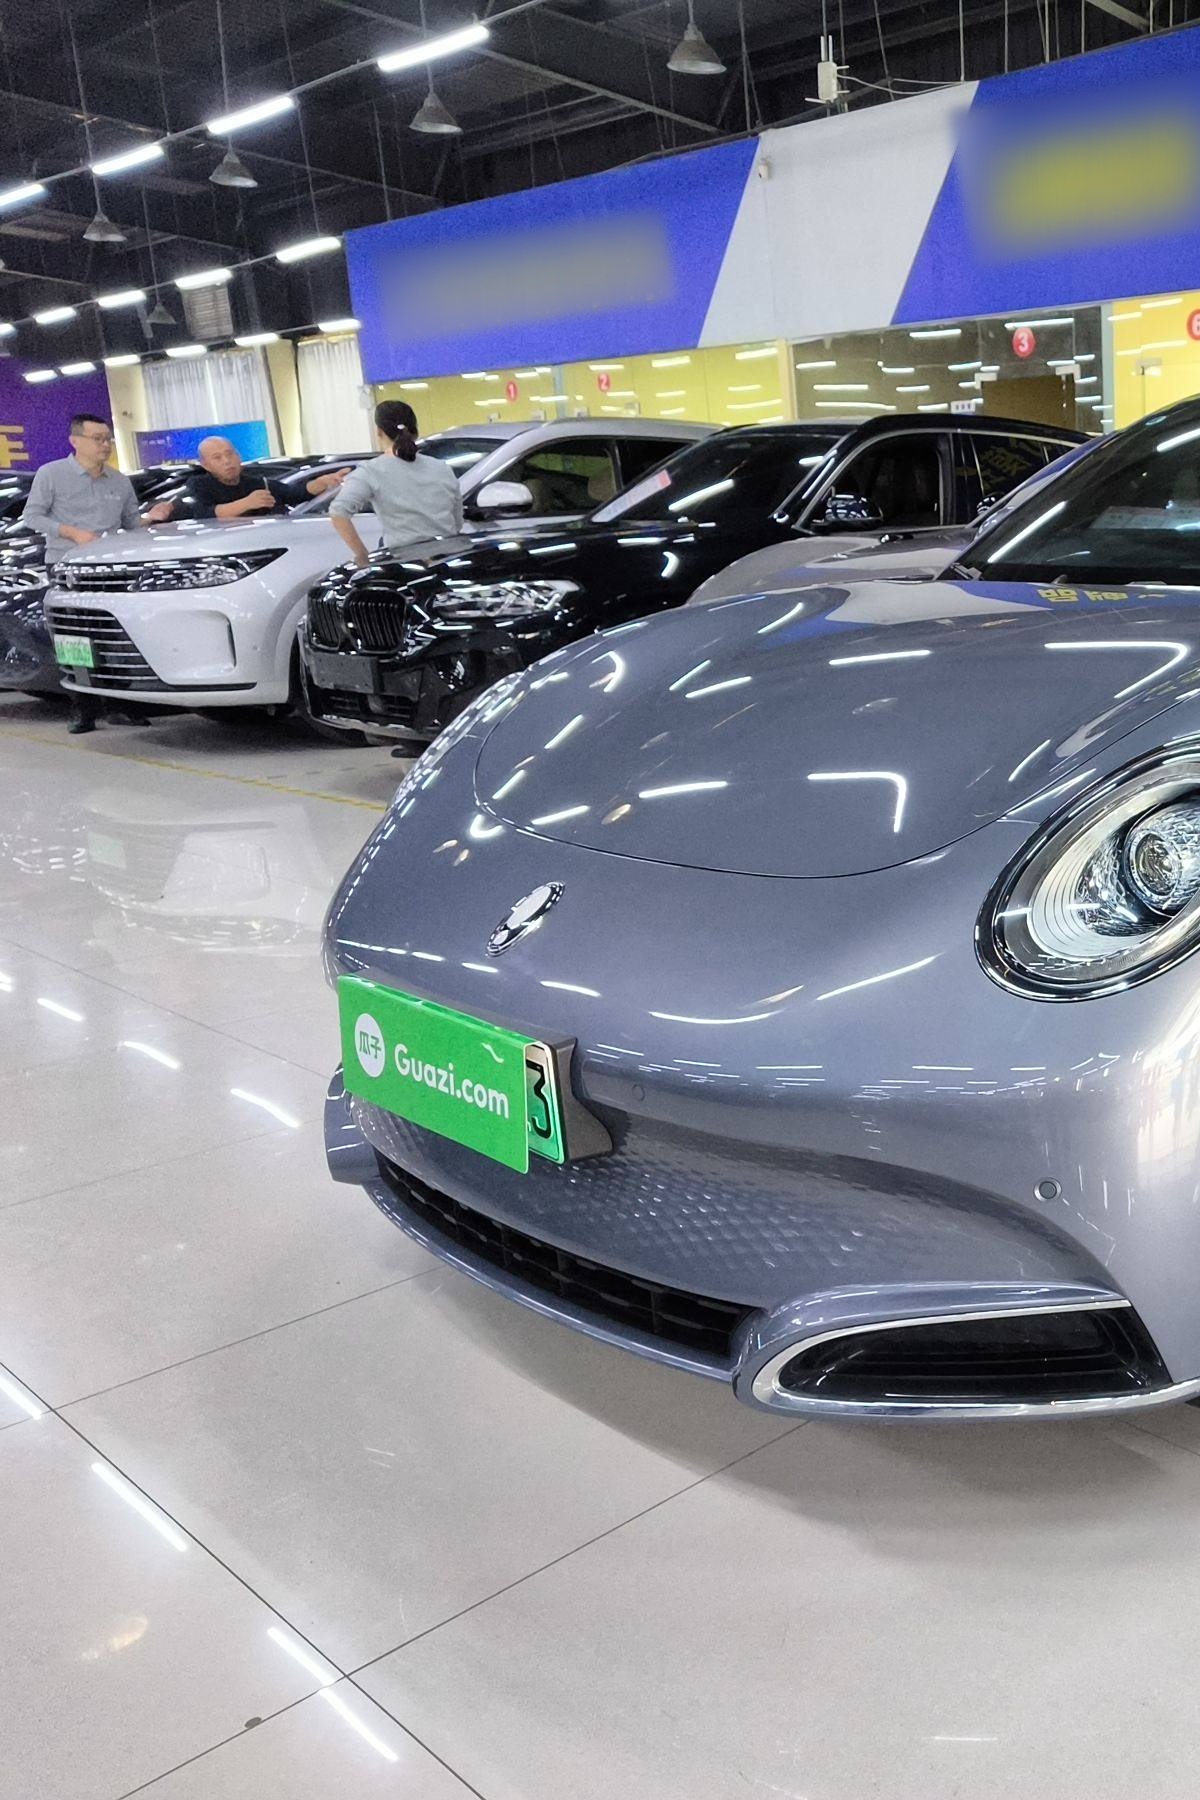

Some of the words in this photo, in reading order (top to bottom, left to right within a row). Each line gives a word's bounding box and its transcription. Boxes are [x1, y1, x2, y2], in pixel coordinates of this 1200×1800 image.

[1017, 332, 1028, 352] 3
[359, 1030, 382, 1060] 瓜子
[394, 1043, 509, 1120] Guazi.com
